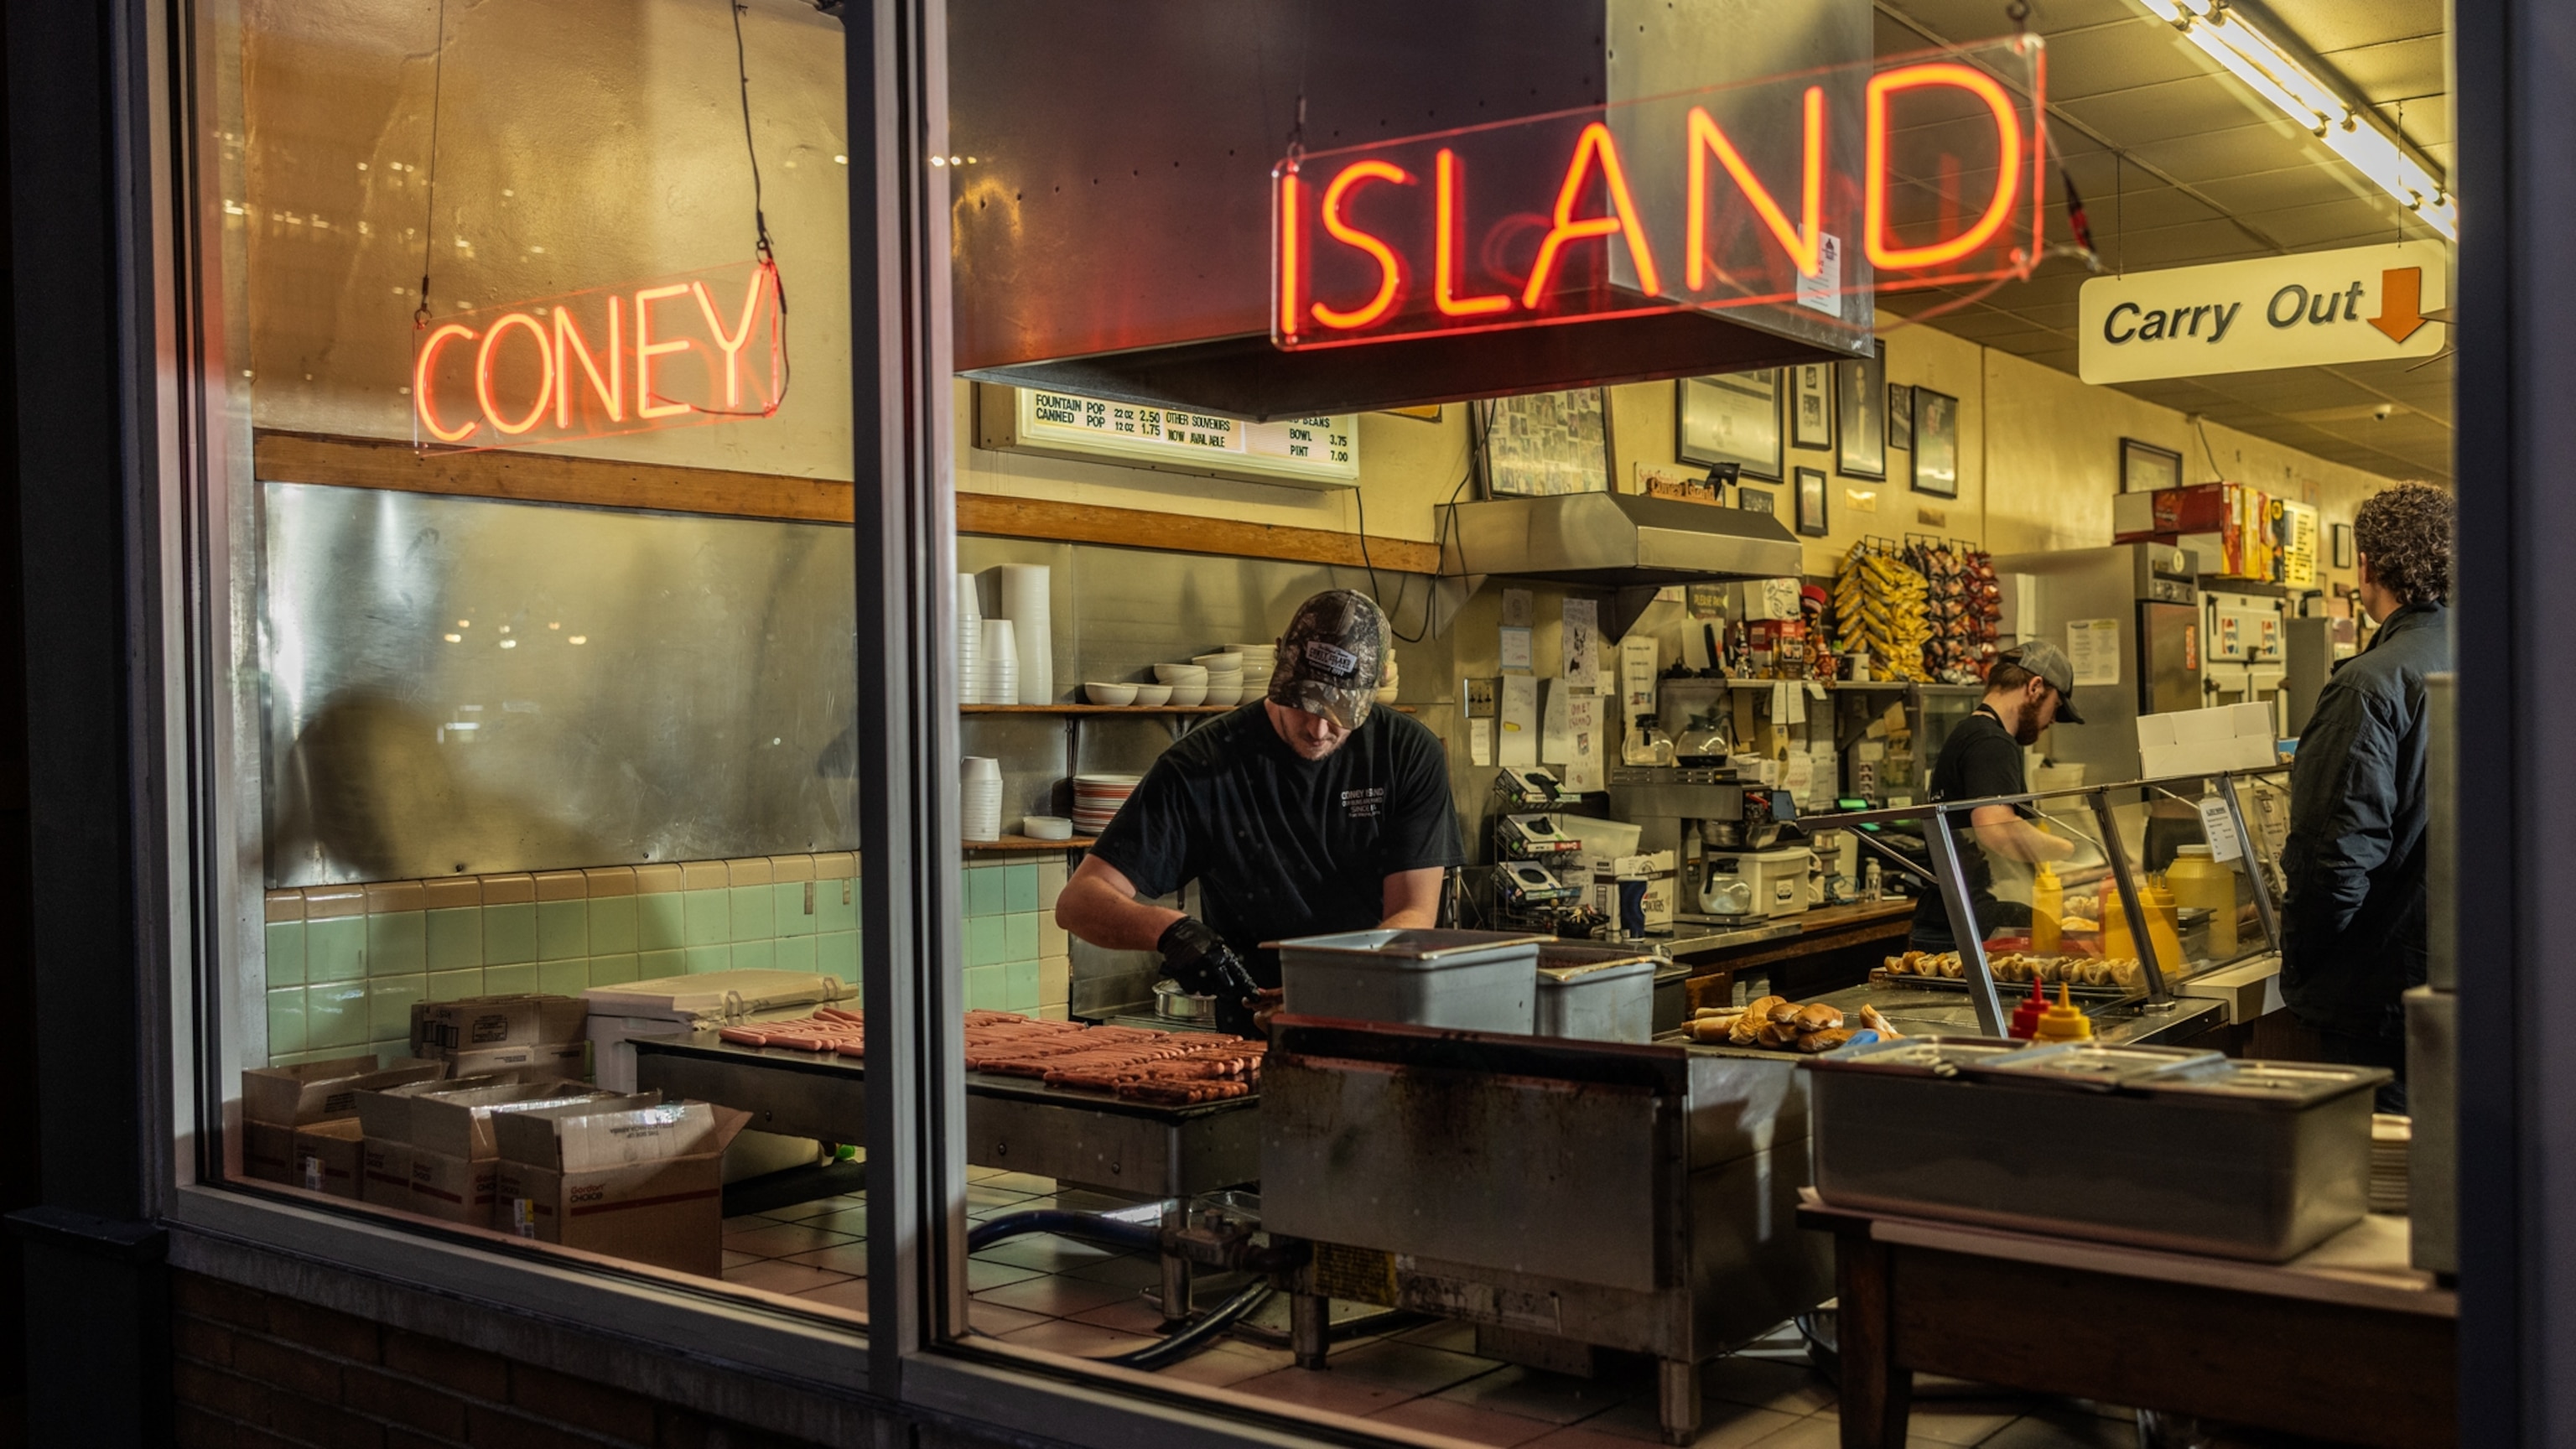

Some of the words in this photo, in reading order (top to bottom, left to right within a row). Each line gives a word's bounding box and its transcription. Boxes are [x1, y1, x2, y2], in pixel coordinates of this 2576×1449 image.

[1280, 62, 2023, 335] ISLAND
[2103, 301, 2242, 344] Carry
[2266, 280, 2364, 328] Out
[417, 267, 766, 441] CONEY
[1036, 393, 1082, 412] FOUNTAIN
[1086, 402, 1105, 416] POP
[1140, 410, 1161, 423] 2.50
[1036, 408, 1075, 423] CANNED
[1086, 415, 1105, 428] POP
[1141, 424, 1161, 436] 1.75
[1166, 412, 1189, 426] OTHER
[1192, 415, 1230, 432] SOUVENIRS
[1303, 416, 1330, 428] BEANS
[1167, 428, 1185, 443] NOW
[1289, 428, 1312, 443] BOWL
[1329, 434, 1348, 447] 3.75
[1290, 444, 1309, 457] PINT
[1330, 451, 1348, 462] 7.00
[570, 1191, 603, 1203] CHOICE
[571, 1183, 605, 1195] Gordon
